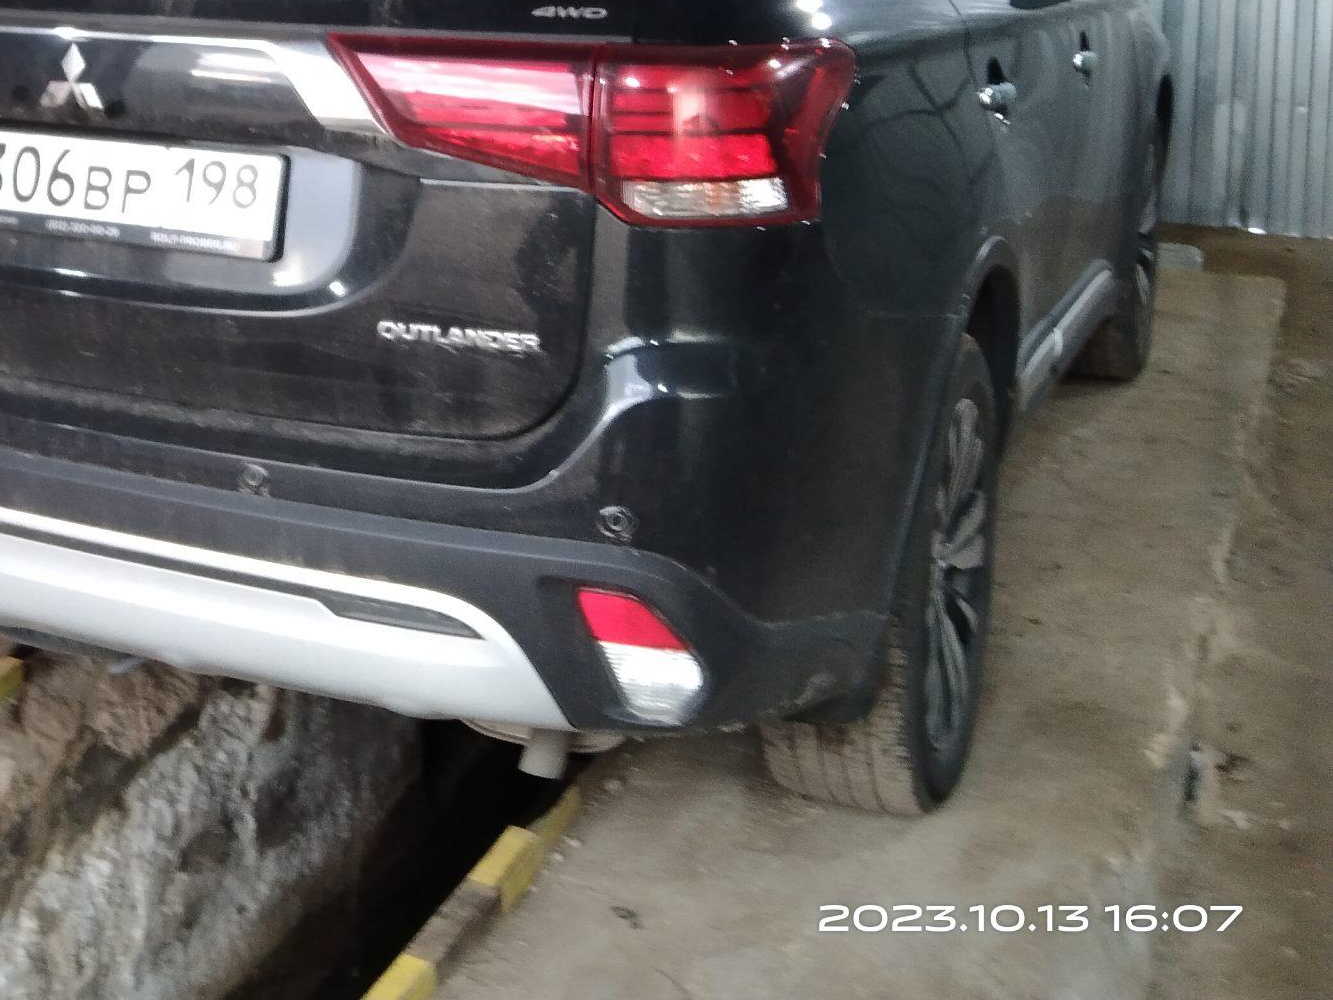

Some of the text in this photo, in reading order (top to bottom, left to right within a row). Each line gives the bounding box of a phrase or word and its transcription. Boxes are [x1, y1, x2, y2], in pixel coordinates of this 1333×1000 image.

[530, 5, 608, 20] 4WD
[174, 157, 260, 210] 198
[376, 319, 542, 352] OUTLANDER
